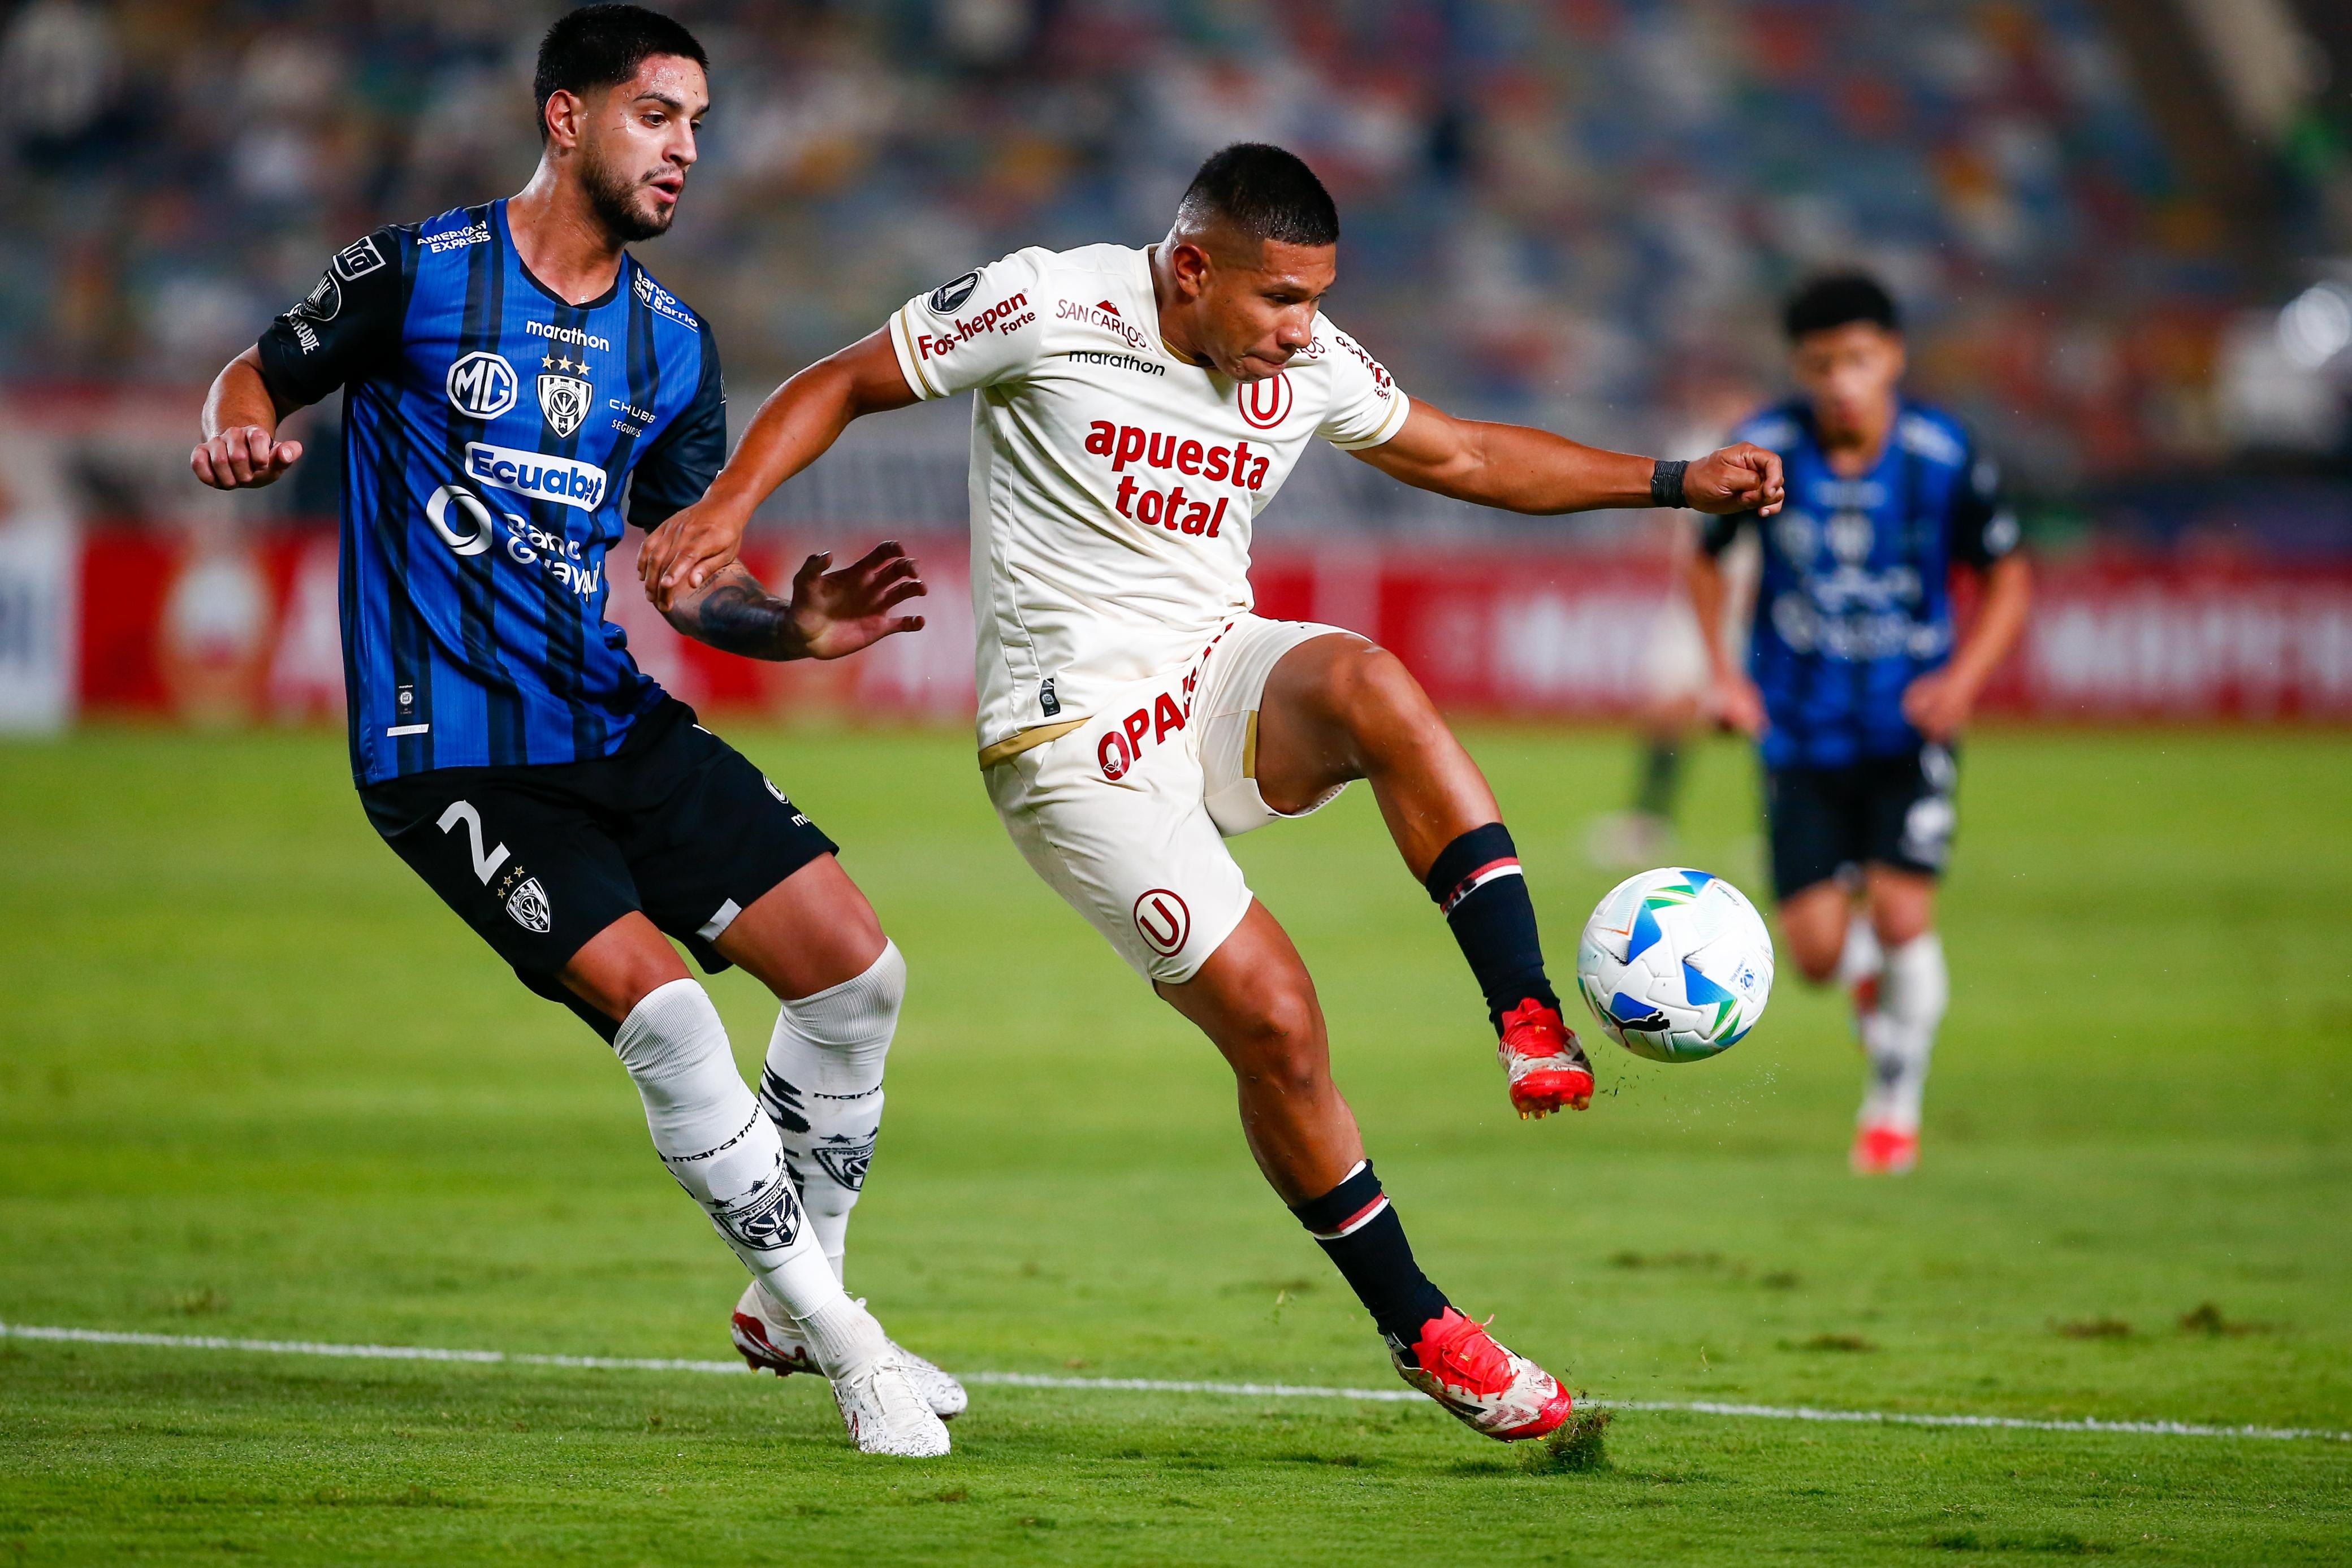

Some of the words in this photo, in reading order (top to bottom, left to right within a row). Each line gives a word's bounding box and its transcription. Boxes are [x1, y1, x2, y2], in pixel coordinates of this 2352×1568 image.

[417, 220, 487, 245] AMERICAN
[430, 231, 491, 254] EXPRESS
[635, 280, 652, 302] del
[654, 295, 698, 327] Barrio
[637, 268, 676, 305] Banco
[526, 320, 609, 352] marathon
[918, 292, 1028, 360] Fos-hepan
[1000, 311, 1036, 336] Forte
[1056, 299, 1088, 323] SAN
[1091, 310, 1147, 348] CARLOS
[1069, 351, 1165, 376] marathon
[455, 360, 510, 412] MG
[547, 382, 582, 396] INDEPENDIENTE
[609, 399, 656, 424] CHUBB
[611, 419, 642, 438] SEGUROS
[471, 448, 602, 505] Ecuabet
[1084, 420, 1270, 491] apuesta
[1115, 475, 1229, 538] total
[436, 800, 511, 886] 2
[672, 1104, 760, 1162] marathon
